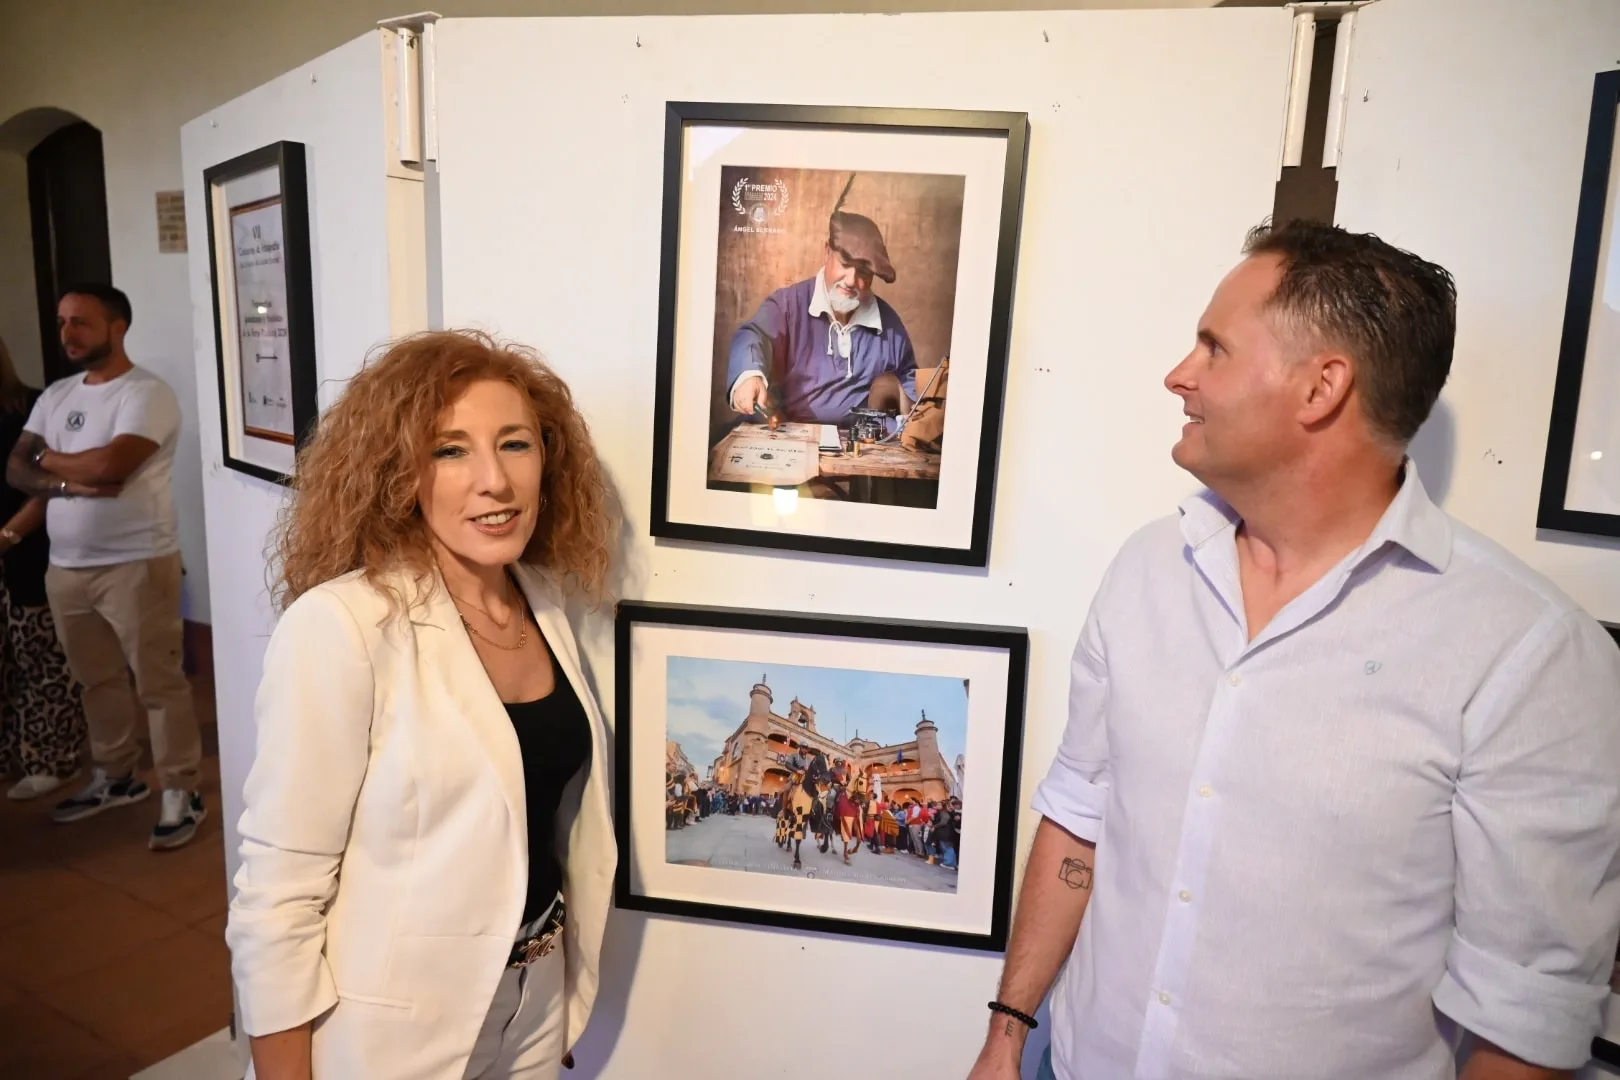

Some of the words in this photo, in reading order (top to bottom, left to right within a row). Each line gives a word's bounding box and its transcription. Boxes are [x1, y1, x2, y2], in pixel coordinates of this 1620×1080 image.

[751, 184, 777, 192] PREMIO
[763, 192, 777, 200] 2024
[733, 225, 755, 233] ÁNGEL
